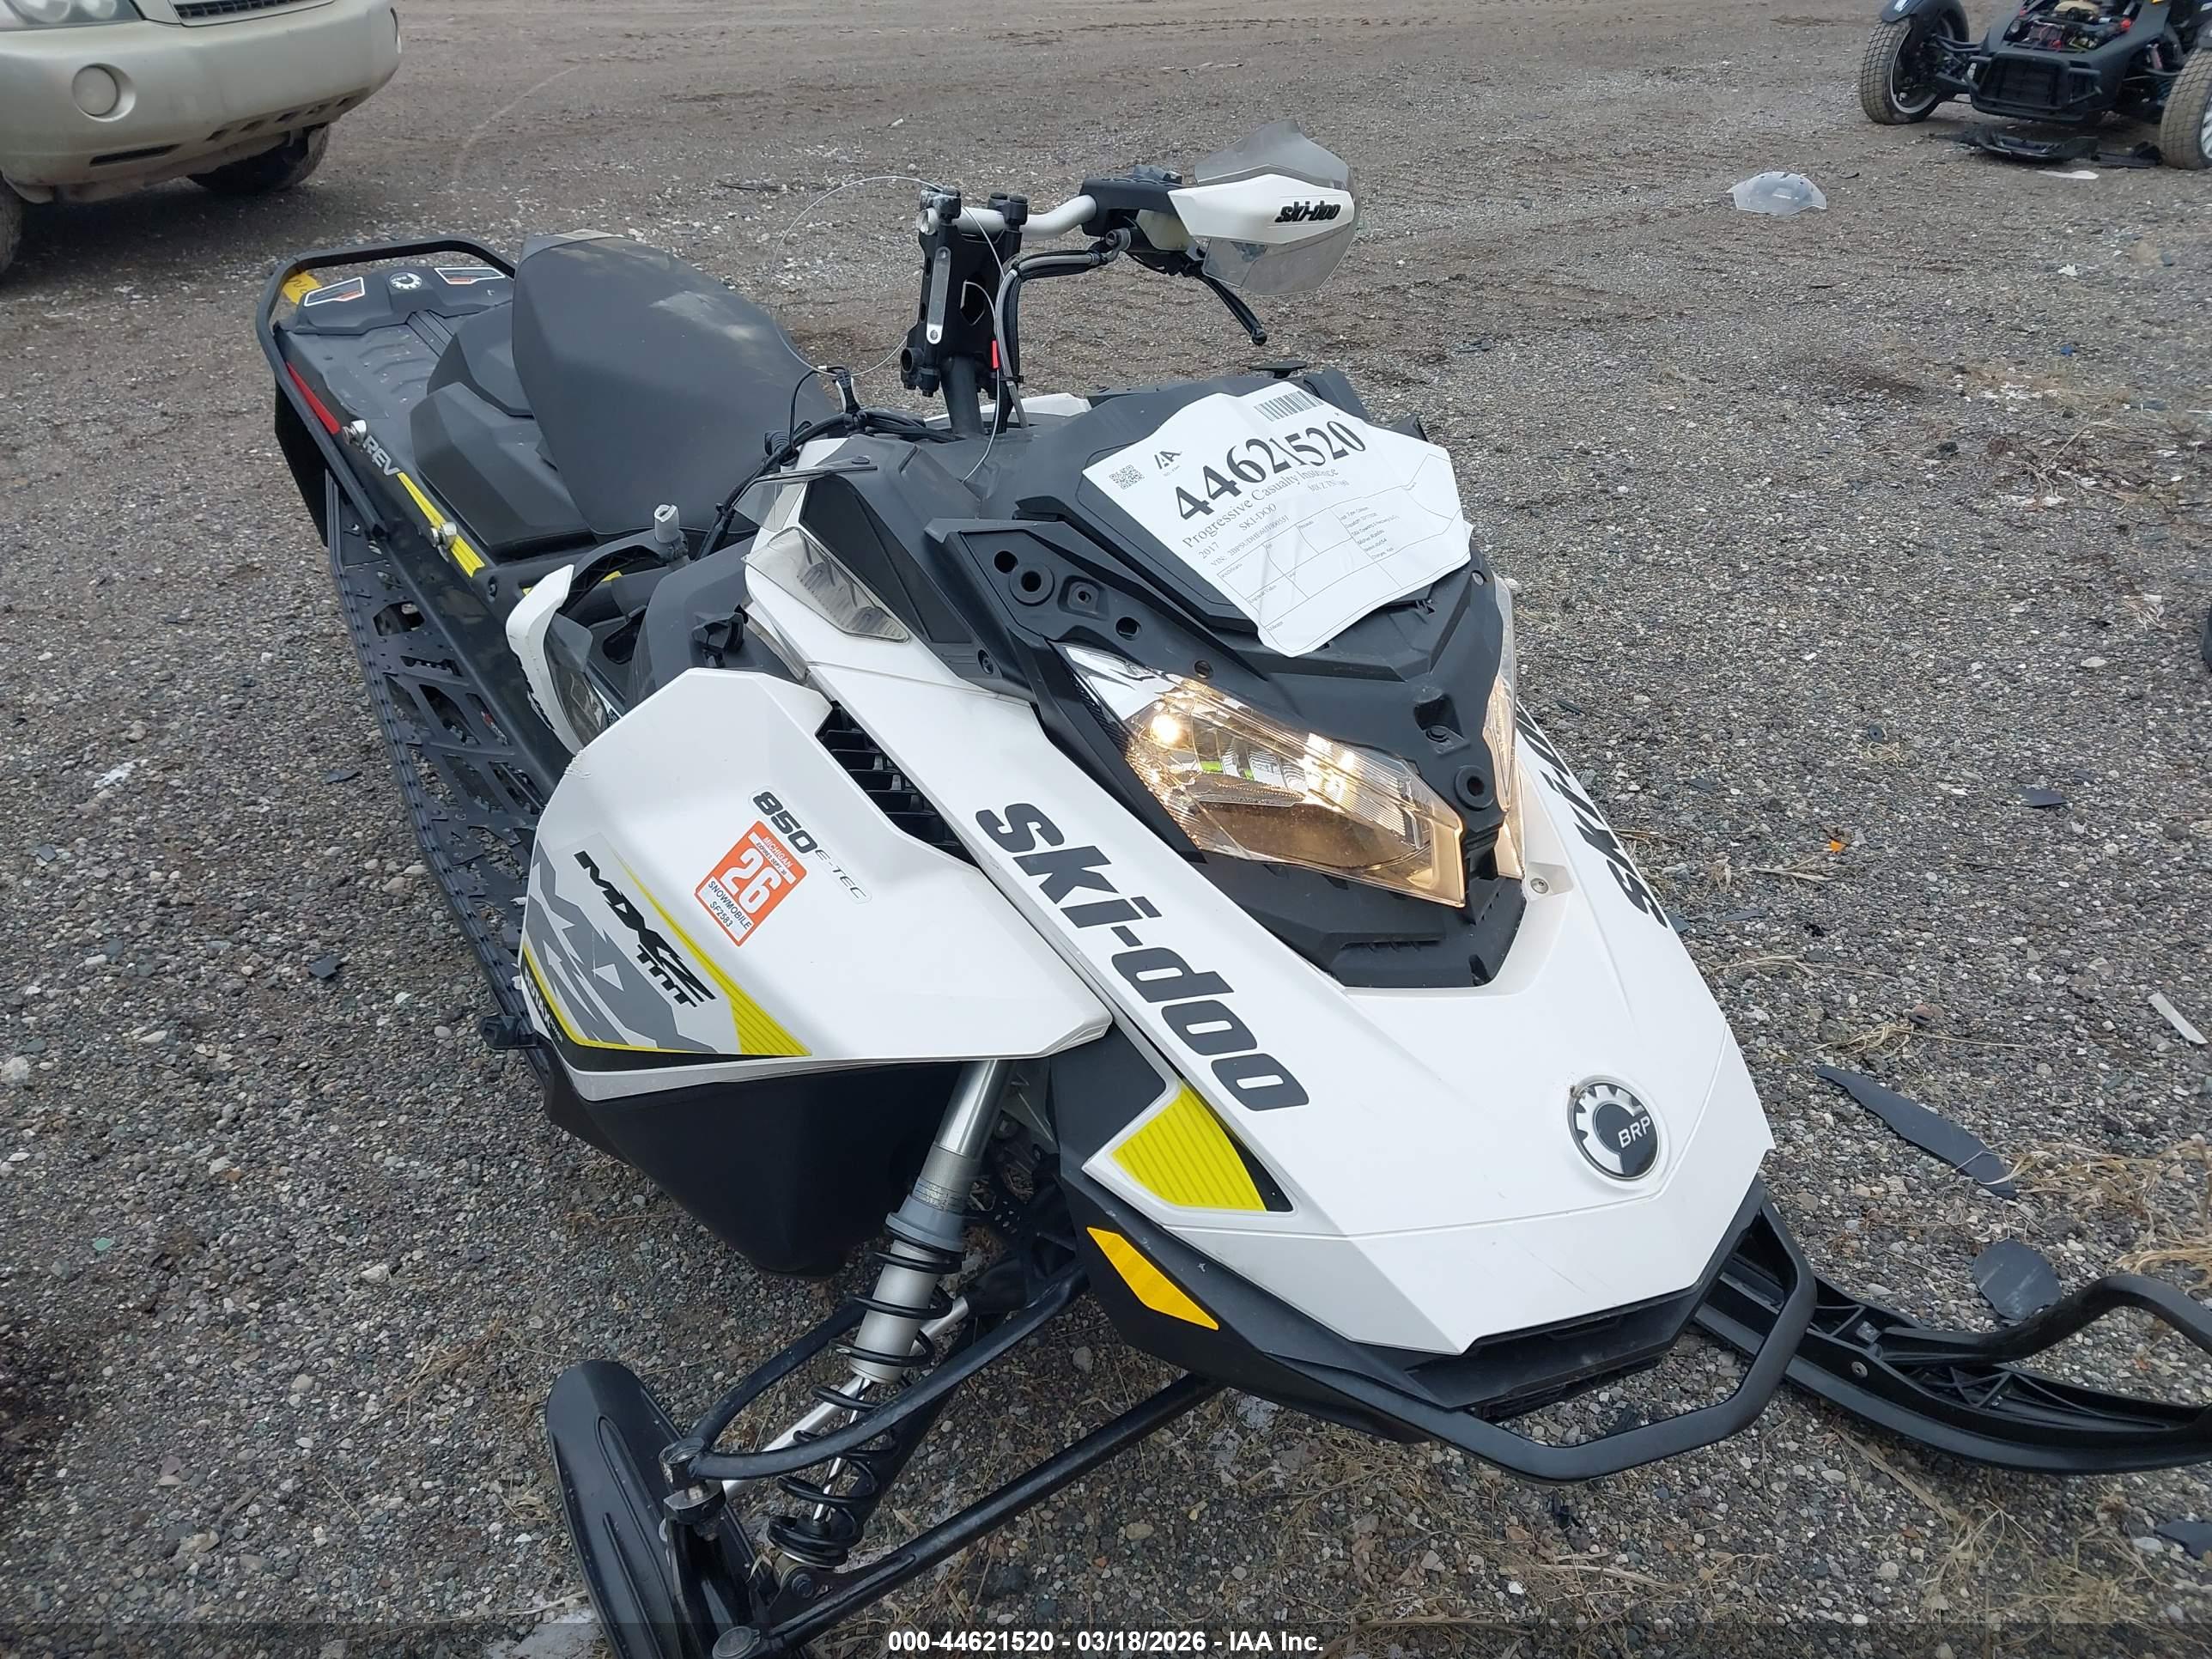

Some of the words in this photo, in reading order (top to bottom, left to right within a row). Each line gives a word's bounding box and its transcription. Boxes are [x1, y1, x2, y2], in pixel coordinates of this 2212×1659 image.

[1274, 200, 1341, 223] ski-doo
[362, 435, 402, 476] REV
[1175, 421, 1366, 520] 44621520
[1182, 499, 1254, 549] Progressive
[1251, 472, 1301, 501] Casualty
[1199, 541, 1220, 560] 2017
[1238, 503, 1278, 531] SKI-DOO
[752, 791, 818, 854] 850
[814, 848, 867, 899] E-TEC
[757, 842, 773, 860] EXPIRES
[762, 836, 794, 869] MICHIGAN
[708, 880, 752, 931] SNOWMOBILE
[719, 847, 783, 915] 26
[709, 901, 733, 927] SF2583
[975, 802, 1310, 1112] ski-doo
[1617, 1115, 1651, 1149] BRP
